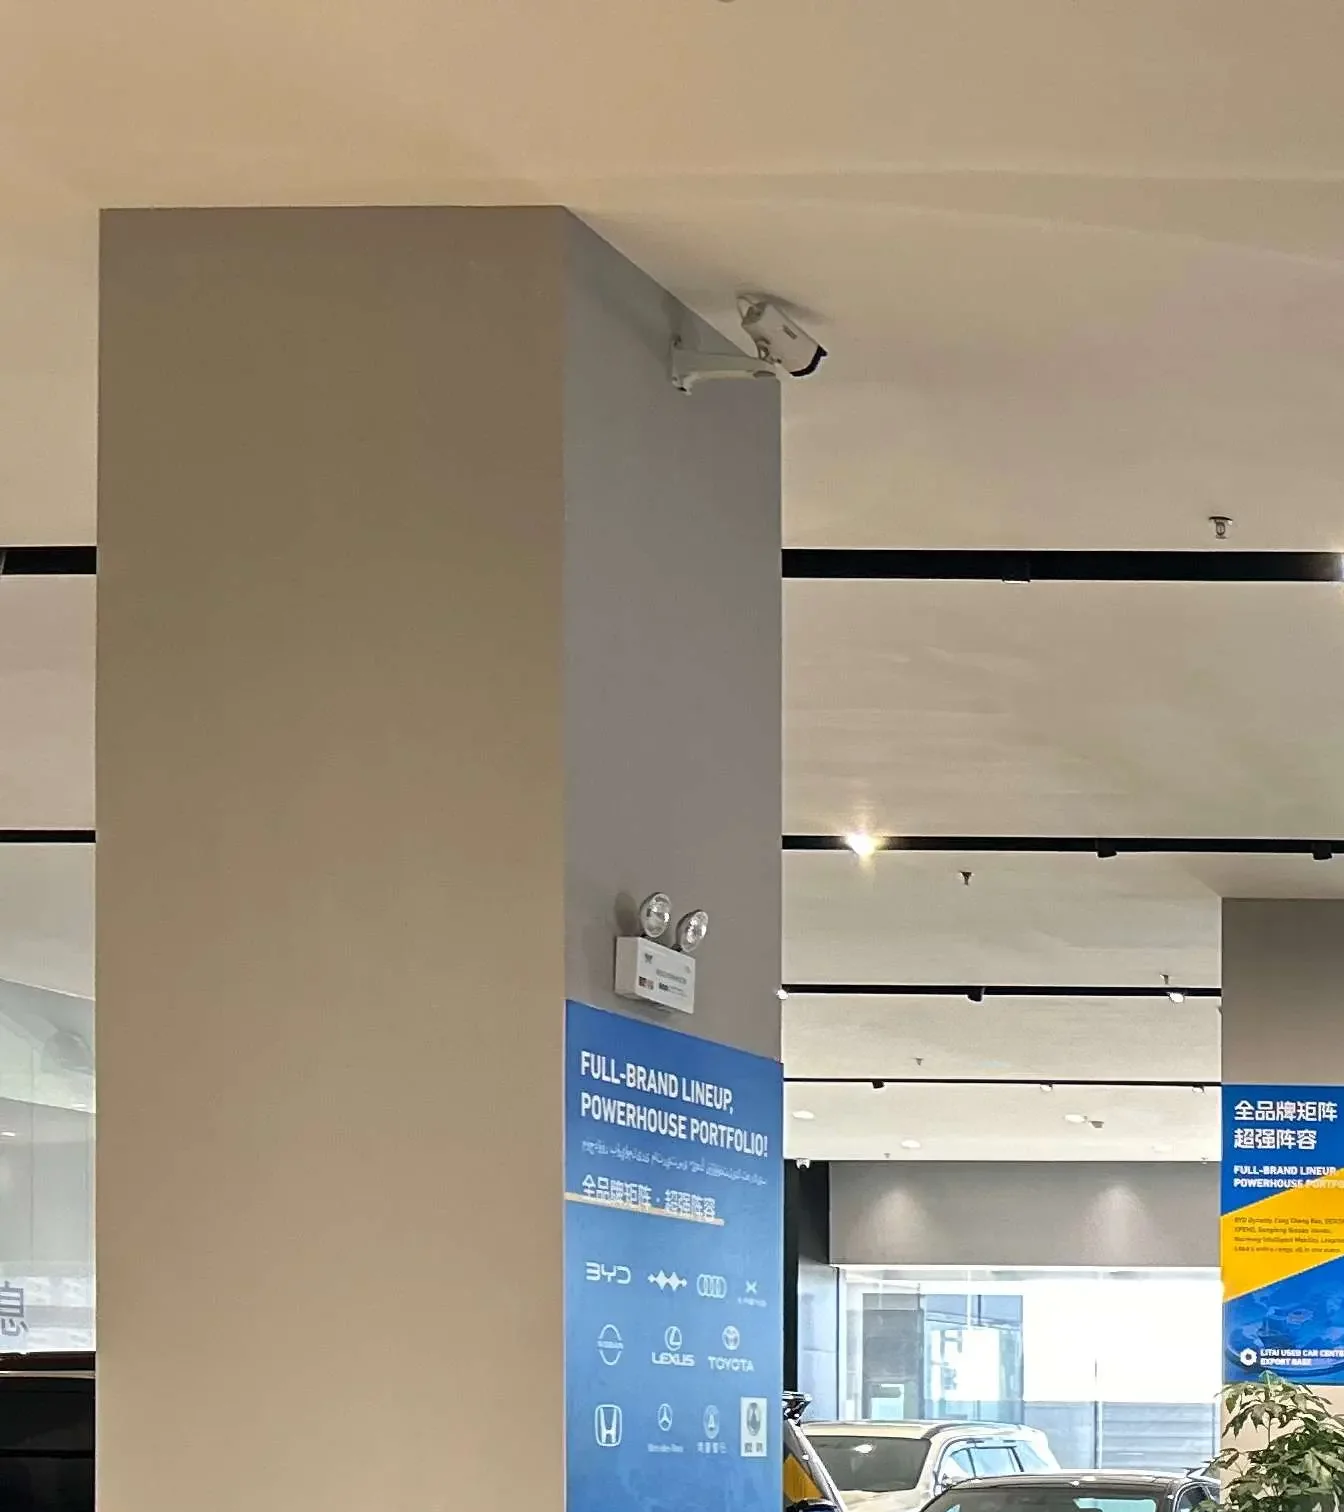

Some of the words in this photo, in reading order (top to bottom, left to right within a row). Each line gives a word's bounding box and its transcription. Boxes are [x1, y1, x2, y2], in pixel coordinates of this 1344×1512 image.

[581, 1050, 679, 1099] FULL-BRAND
[682, 1077, 734, 1115] LINEUP,
[1233, 1100, 1338, 1122] 全品牌矩阵
[581, 1092, 687, 1140] POWERHOUSE
[690, 1118, 768, 1157] PORTFOLIO!
[1233, 1128, 1318, 1150] 超强阵容
[1233, 1165, 1297, 1175] FULL-BRAND
[1233, 1178, 1304, 1188] POWERHOUSE
[585, 1261, 632, 1285] BYD
[651, 1352, 695, 1367] LEXUS
[707, 1356, 755, 1373] TOYOTA
